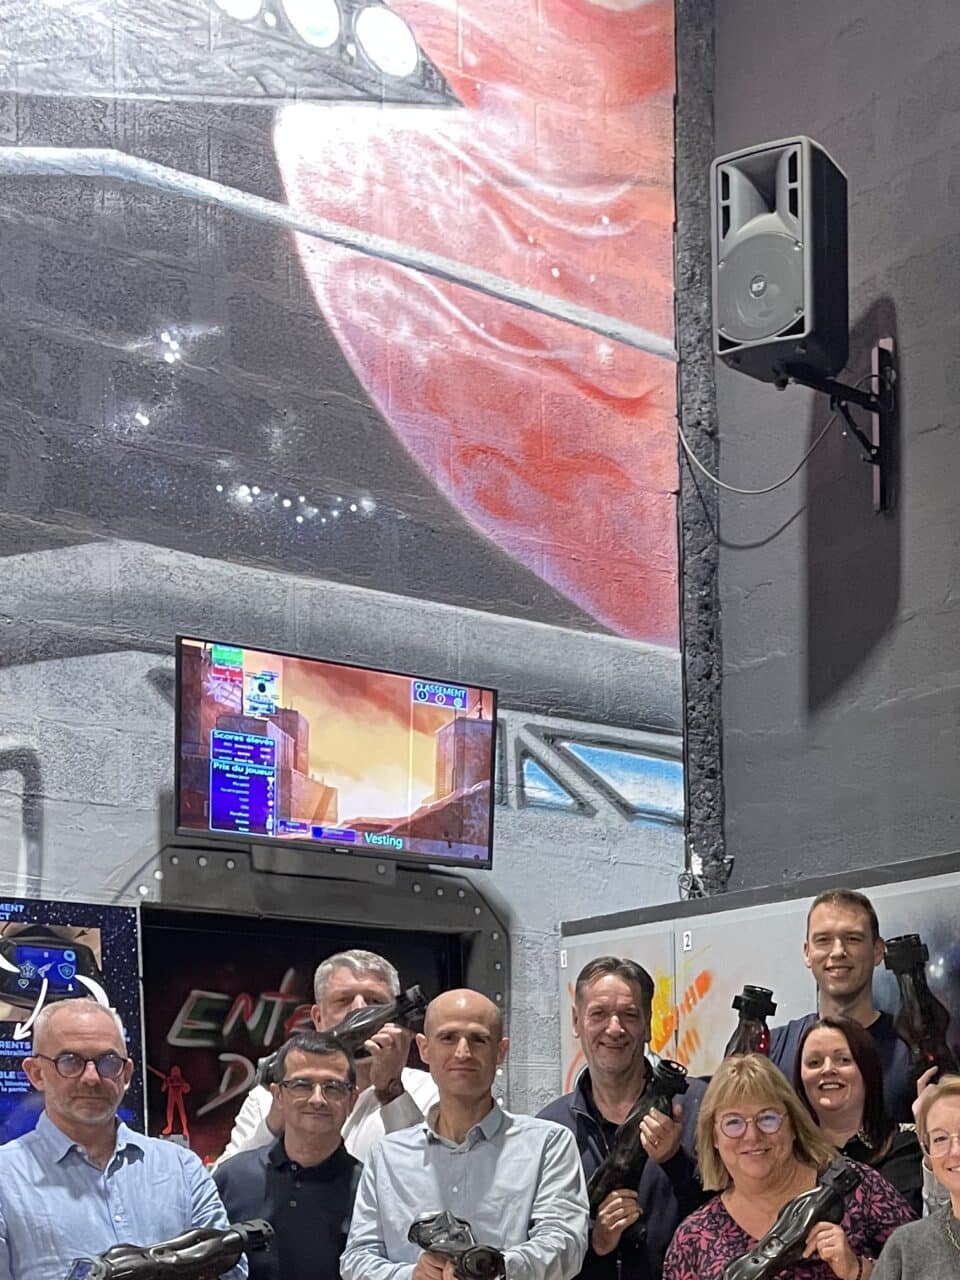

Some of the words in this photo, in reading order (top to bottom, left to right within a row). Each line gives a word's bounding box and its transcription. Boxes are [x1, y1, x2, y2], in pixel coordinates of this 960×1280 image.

[415, 682, 465, 698] CLASSEMENT
[213, 731, 244, 741] Scores
[364, 831, 403, 849] Vesting
[167, 967, 312, 1047] ENT
